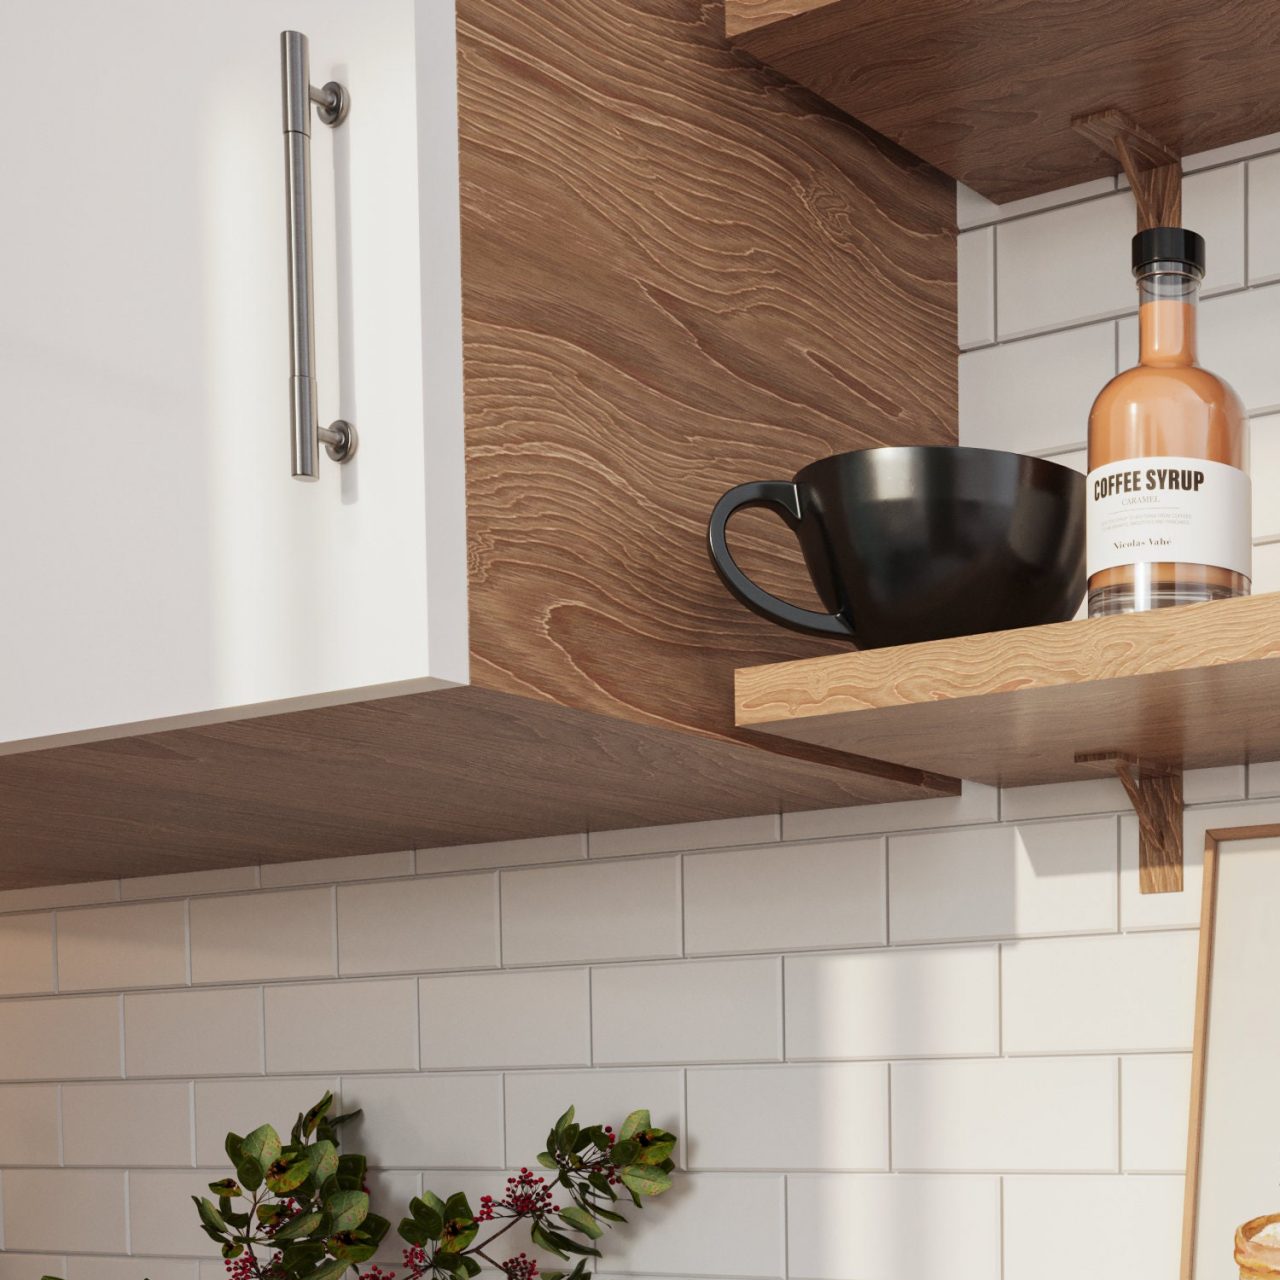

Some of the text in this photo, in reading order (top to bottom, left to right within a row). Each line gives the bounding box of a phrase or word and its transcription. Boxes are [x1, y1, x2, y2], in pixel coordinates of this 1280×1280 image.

[1094, 469, 1205, 502] COFFEE SYRUP
[1113, 539, 1146, 550] Nicolas
